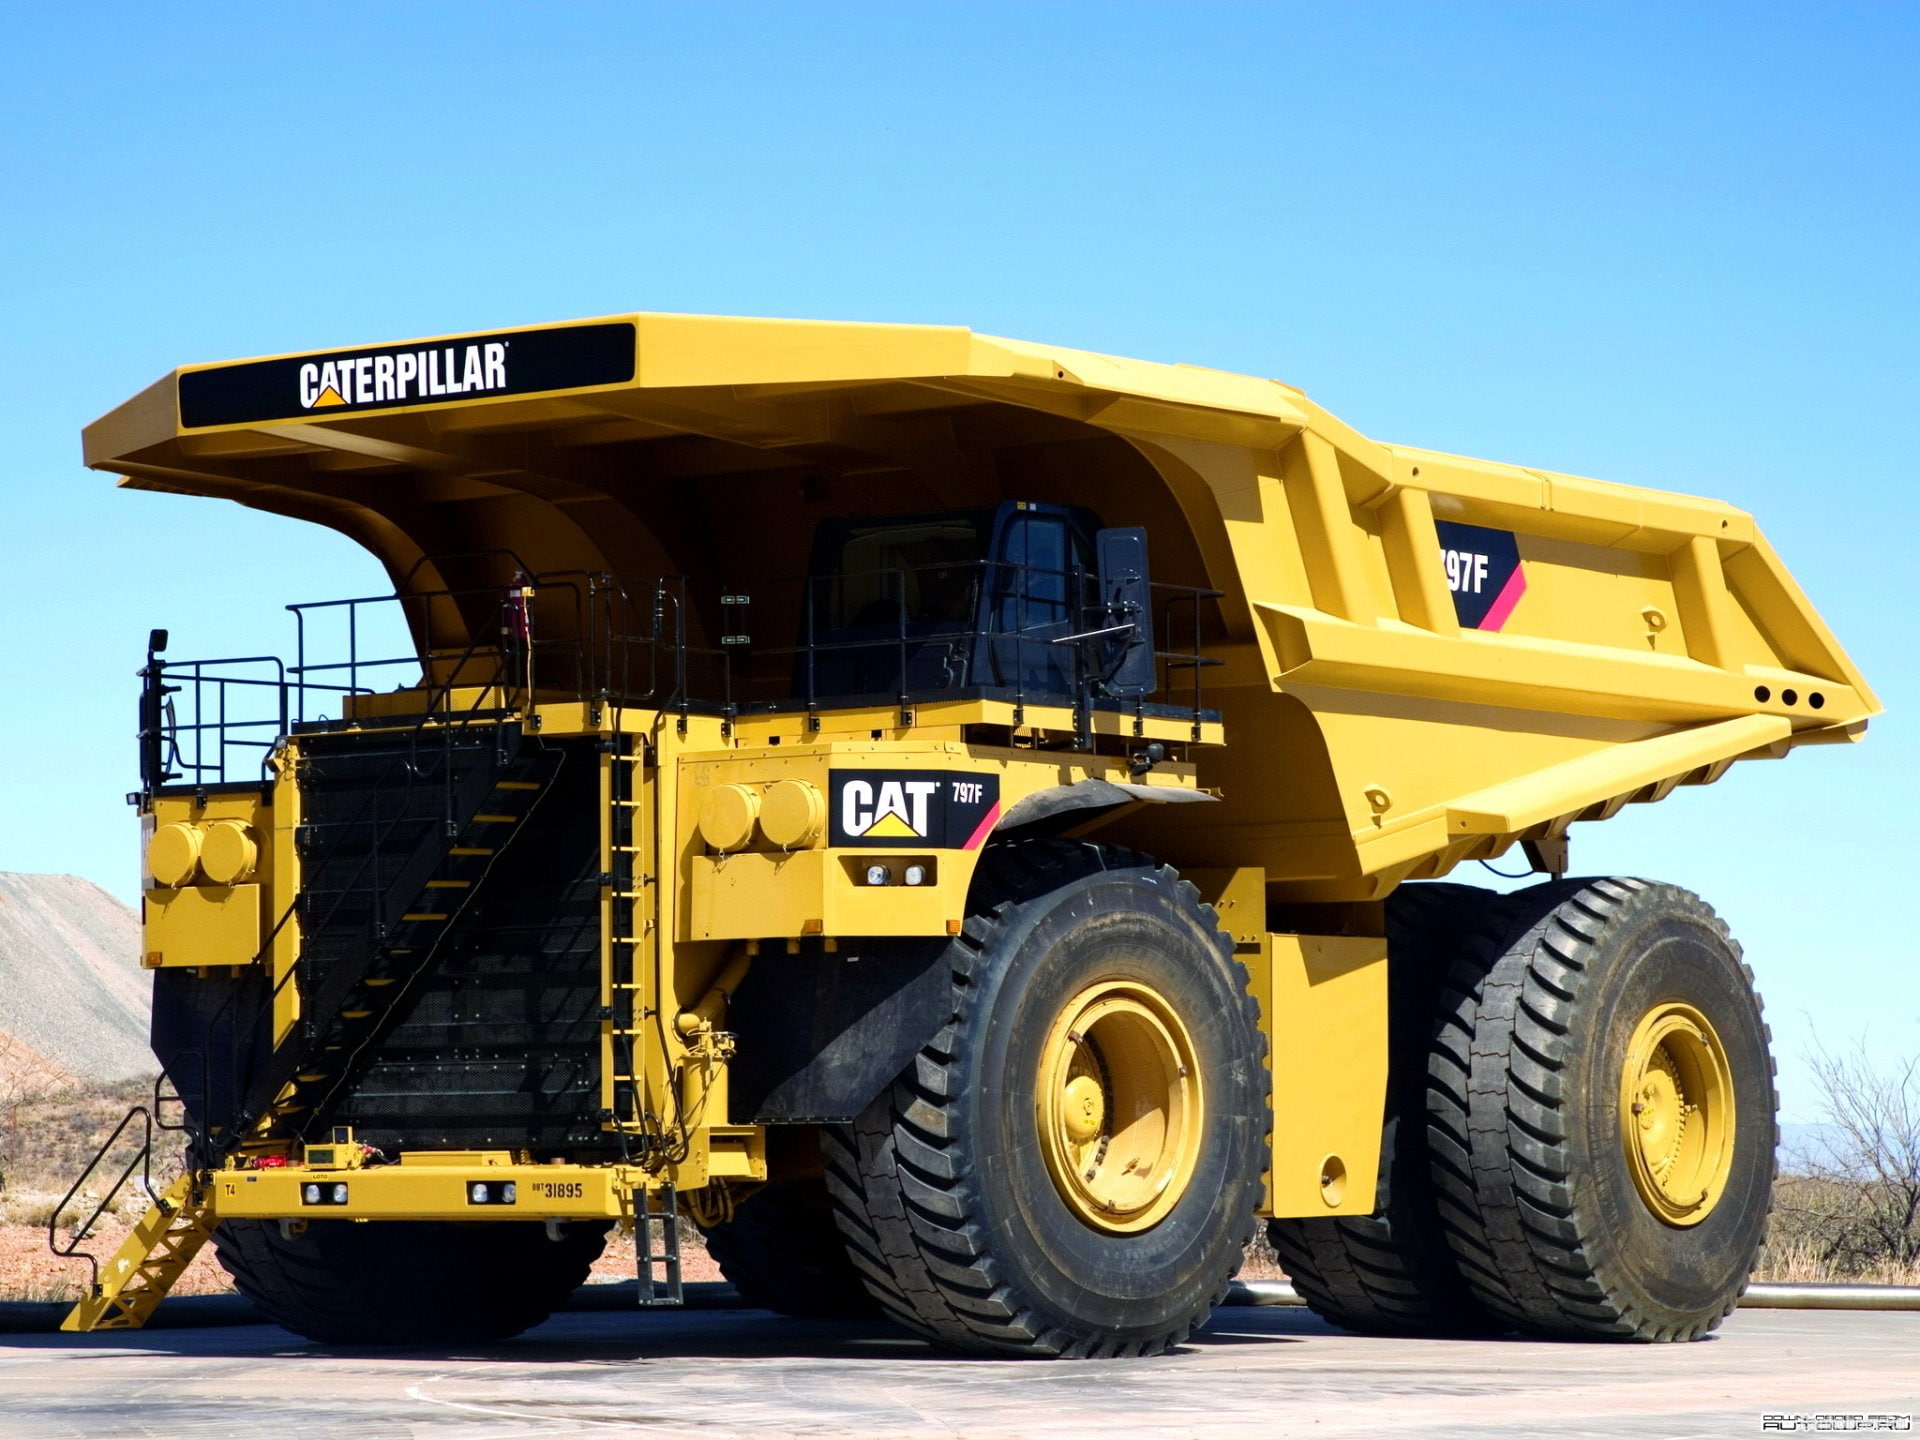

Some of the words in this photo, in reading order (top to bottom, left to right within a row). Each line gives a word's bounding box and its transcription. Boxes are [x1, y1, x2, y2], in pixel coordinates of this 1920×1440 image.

[300, 342, 507, 409] CATERPILLAR
[843, 780, 936, 837] CAT
[952, 782, 983, 804] 797F
[225, 1184, 235, 1196] T4
[545, 1183, 583, 1198] 31895
